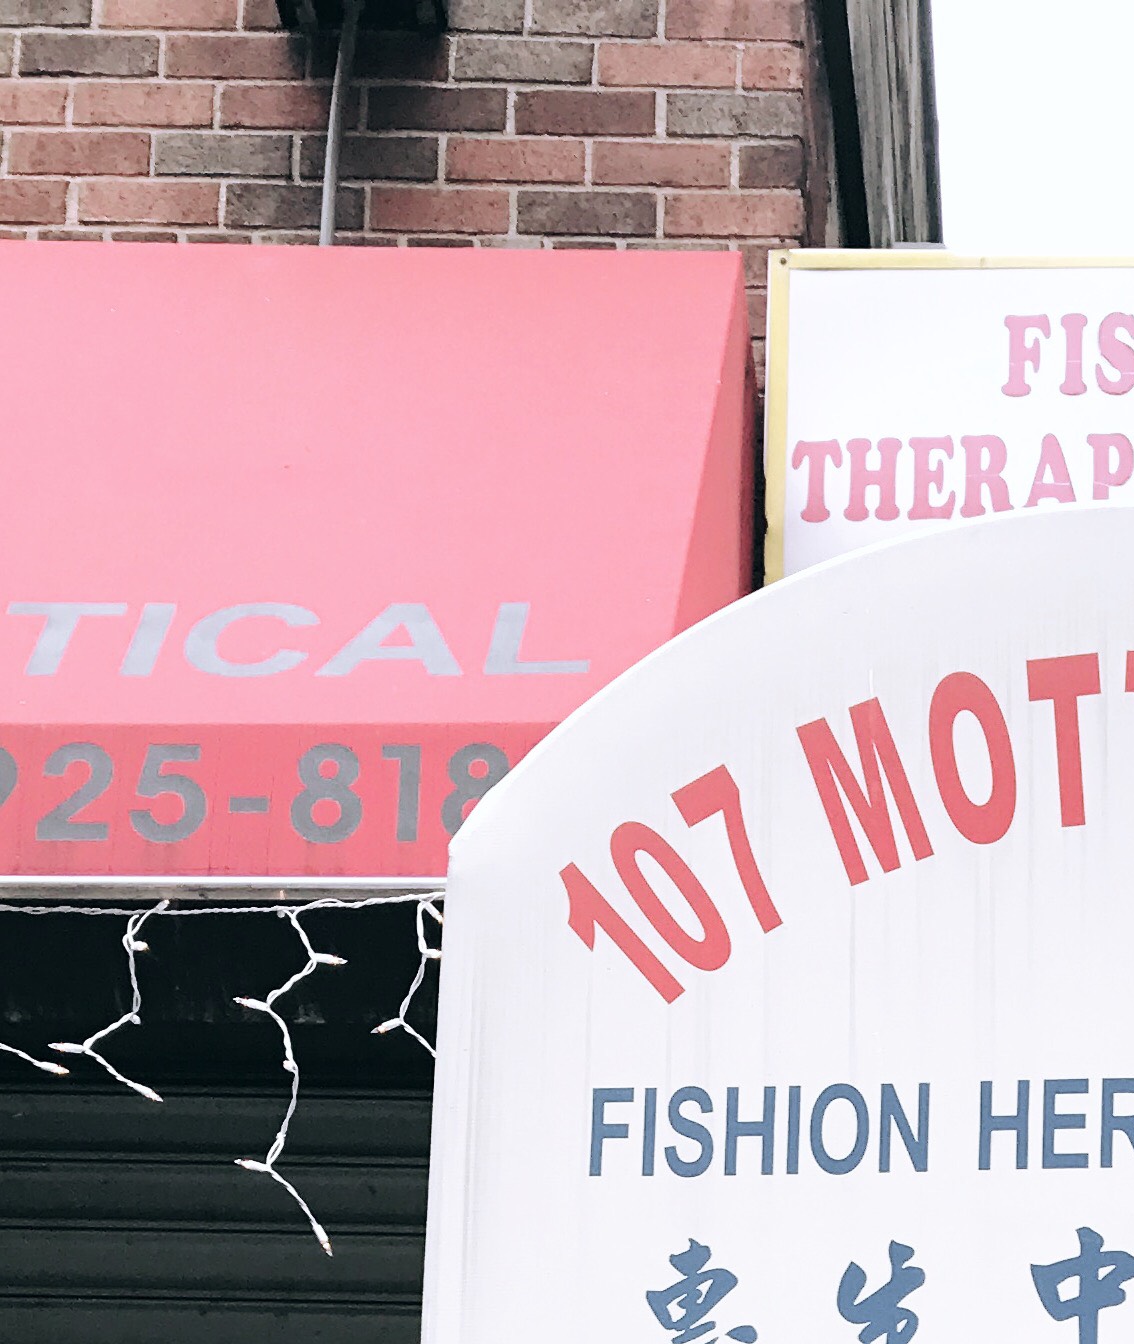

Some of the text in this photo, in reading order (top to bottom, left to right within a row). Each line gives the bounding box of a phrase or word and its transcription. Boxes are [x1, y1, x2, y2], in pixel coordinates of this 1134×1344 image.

[6, 601, 591, 677] TICAL
[0, 743, 510, 844] 25-818
[559, 764, 783, 1005] 107
[588, 1082, 931, 1178] FISHION
